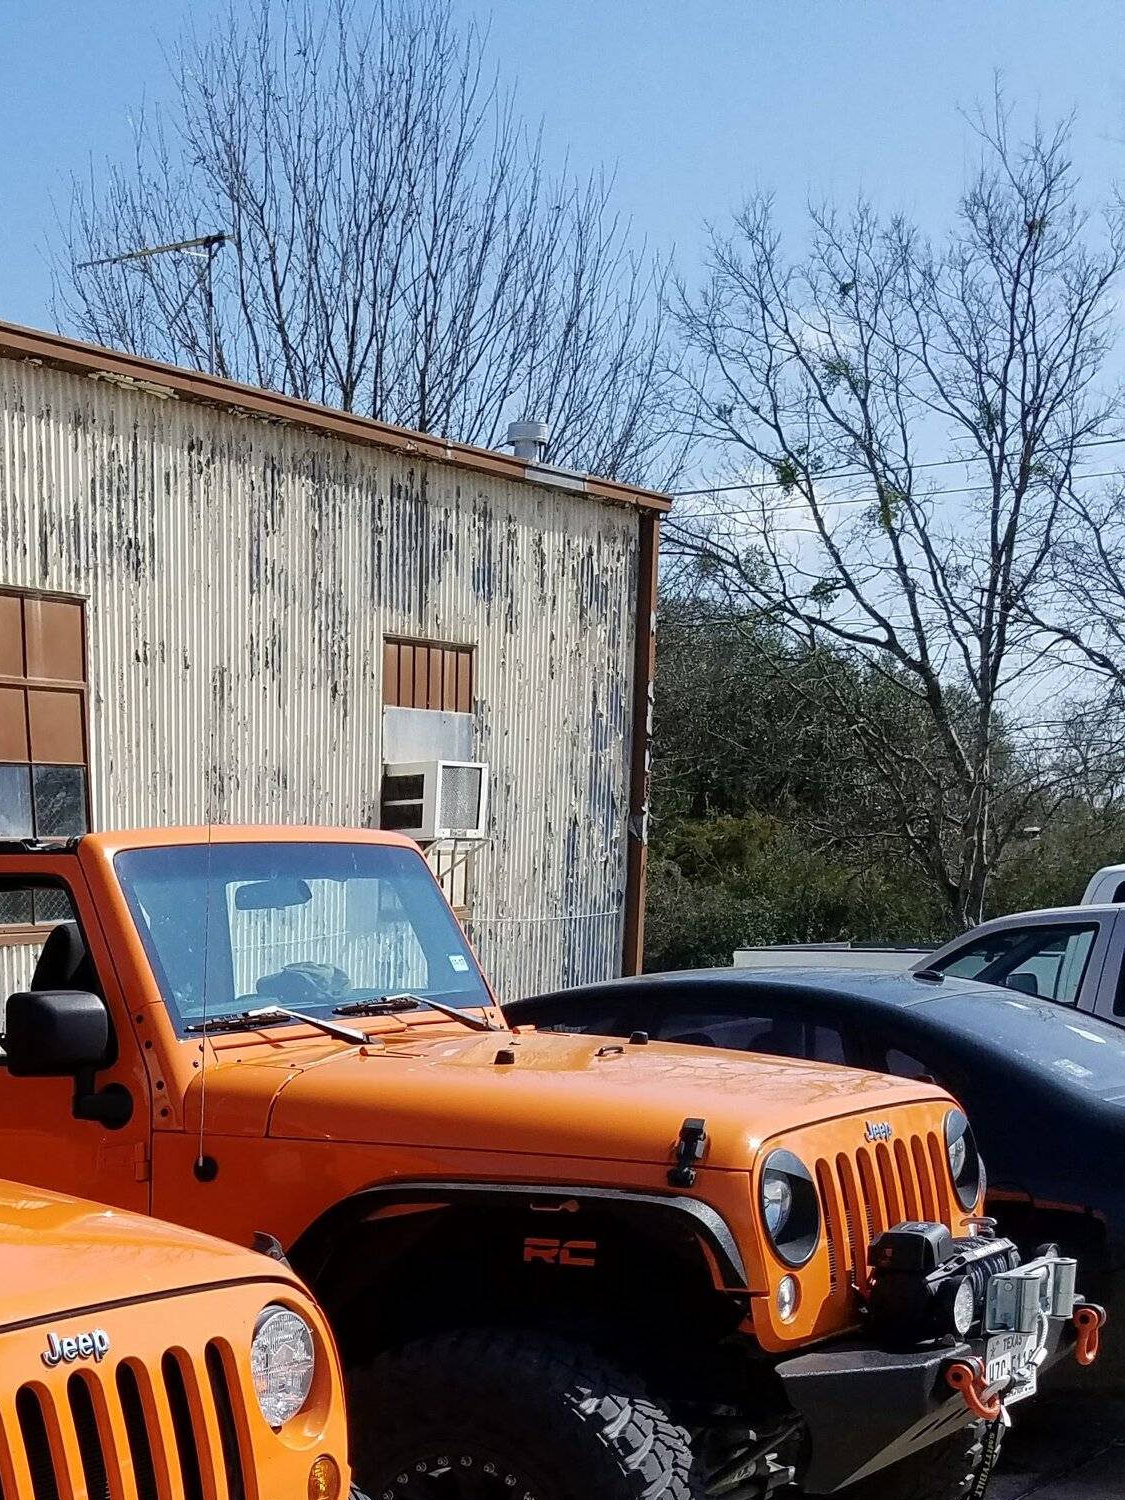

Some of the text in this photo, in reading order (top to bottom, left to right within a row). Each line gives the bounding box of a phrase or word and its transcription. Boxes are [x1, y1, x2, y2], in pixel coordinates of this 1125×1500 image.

[864, 1120, 892, 1143] Jeep
[523, 1237, 596, 1266] RC
[41, 1329, 110, 1367] Jeep
[1003, 1335, 1023, 1352] TEXAS
